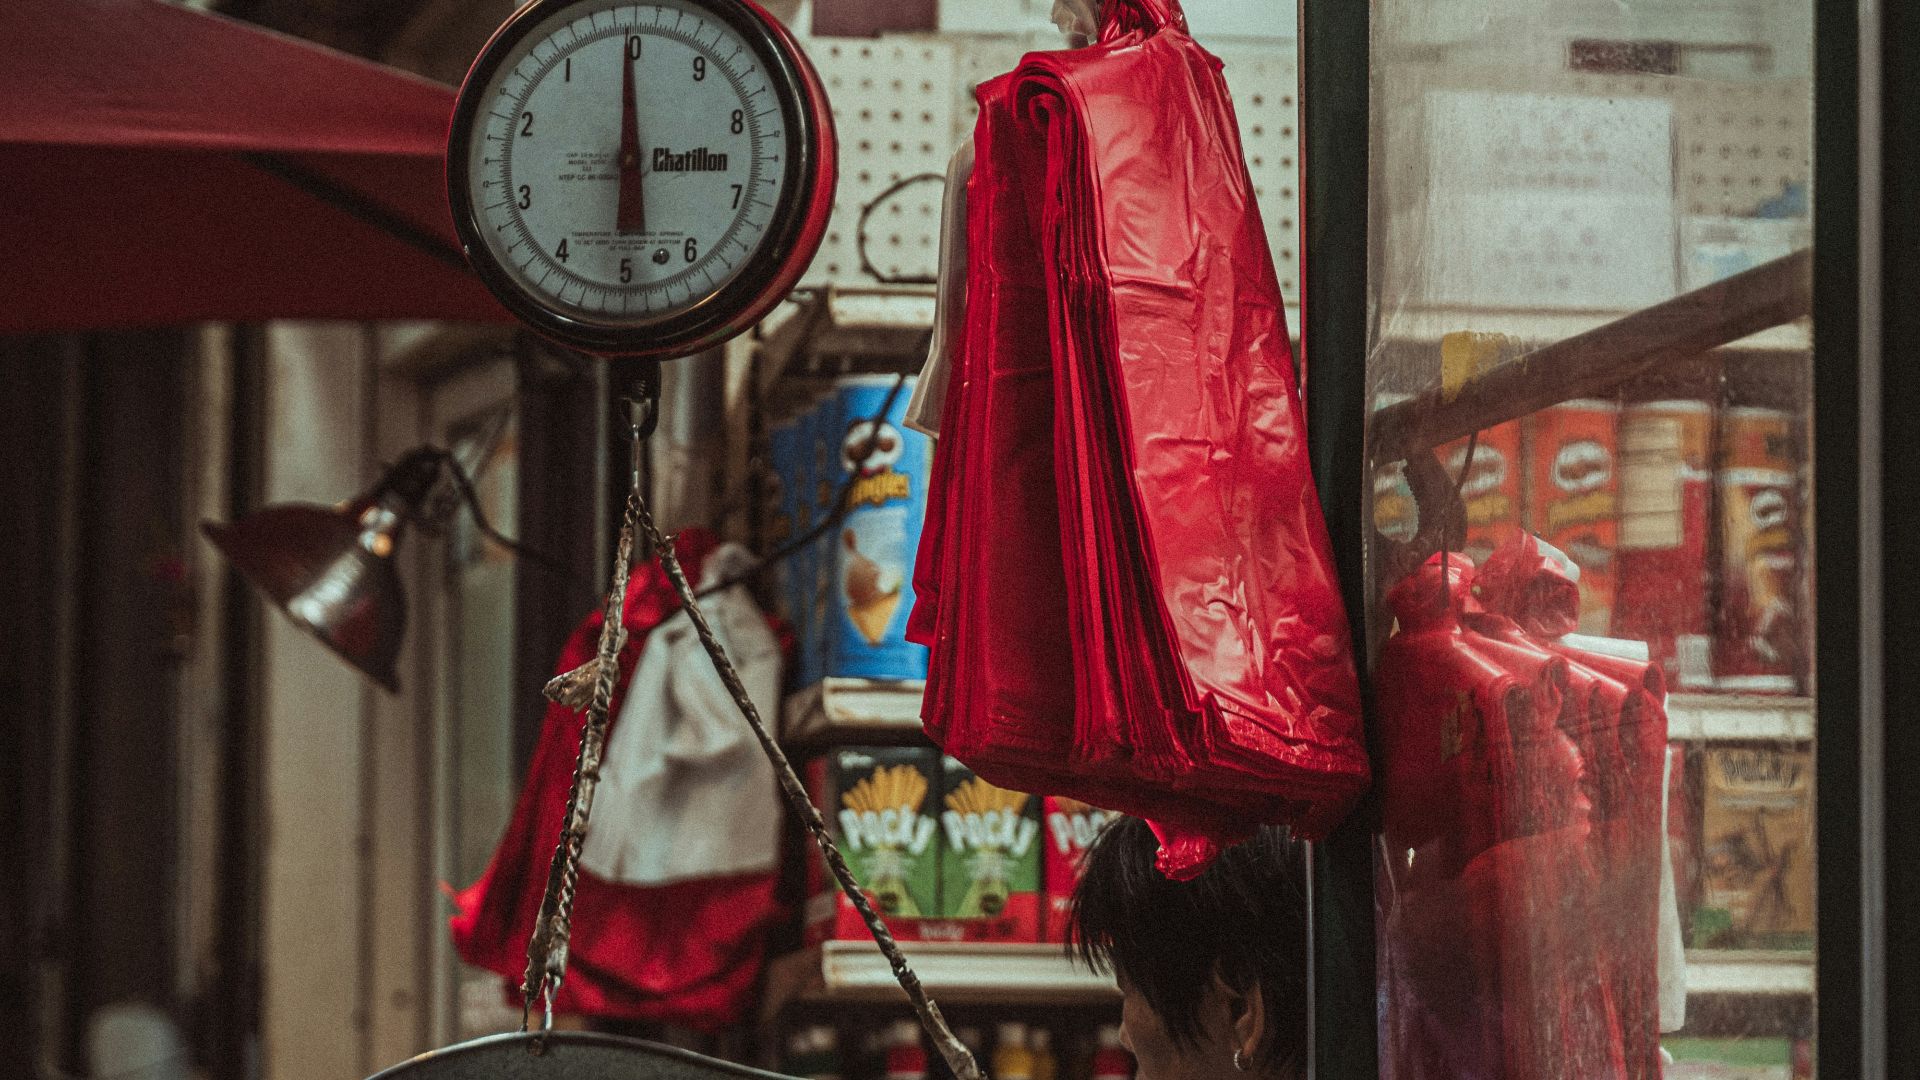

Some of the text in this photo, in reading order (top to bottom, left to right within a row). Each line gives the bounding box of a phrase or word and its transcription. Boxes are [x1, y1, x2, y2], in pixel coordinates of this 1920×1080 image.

[629, 35, 642, 60] 0
[565, 57, 571, 82] 1
[693, 56, 706, 81] 9
[521, 111, 533, 137] 2
[731, 109, 744, 134] 8
[652, 147, 728, 171] Chatillon
[518, 185, 531, 210] 3
[731, 184, 742, 209] 7
[556, 238, 569, 263] 4
[684, 237, 697, 262] 6
[620, 257, 633, 284] 5
